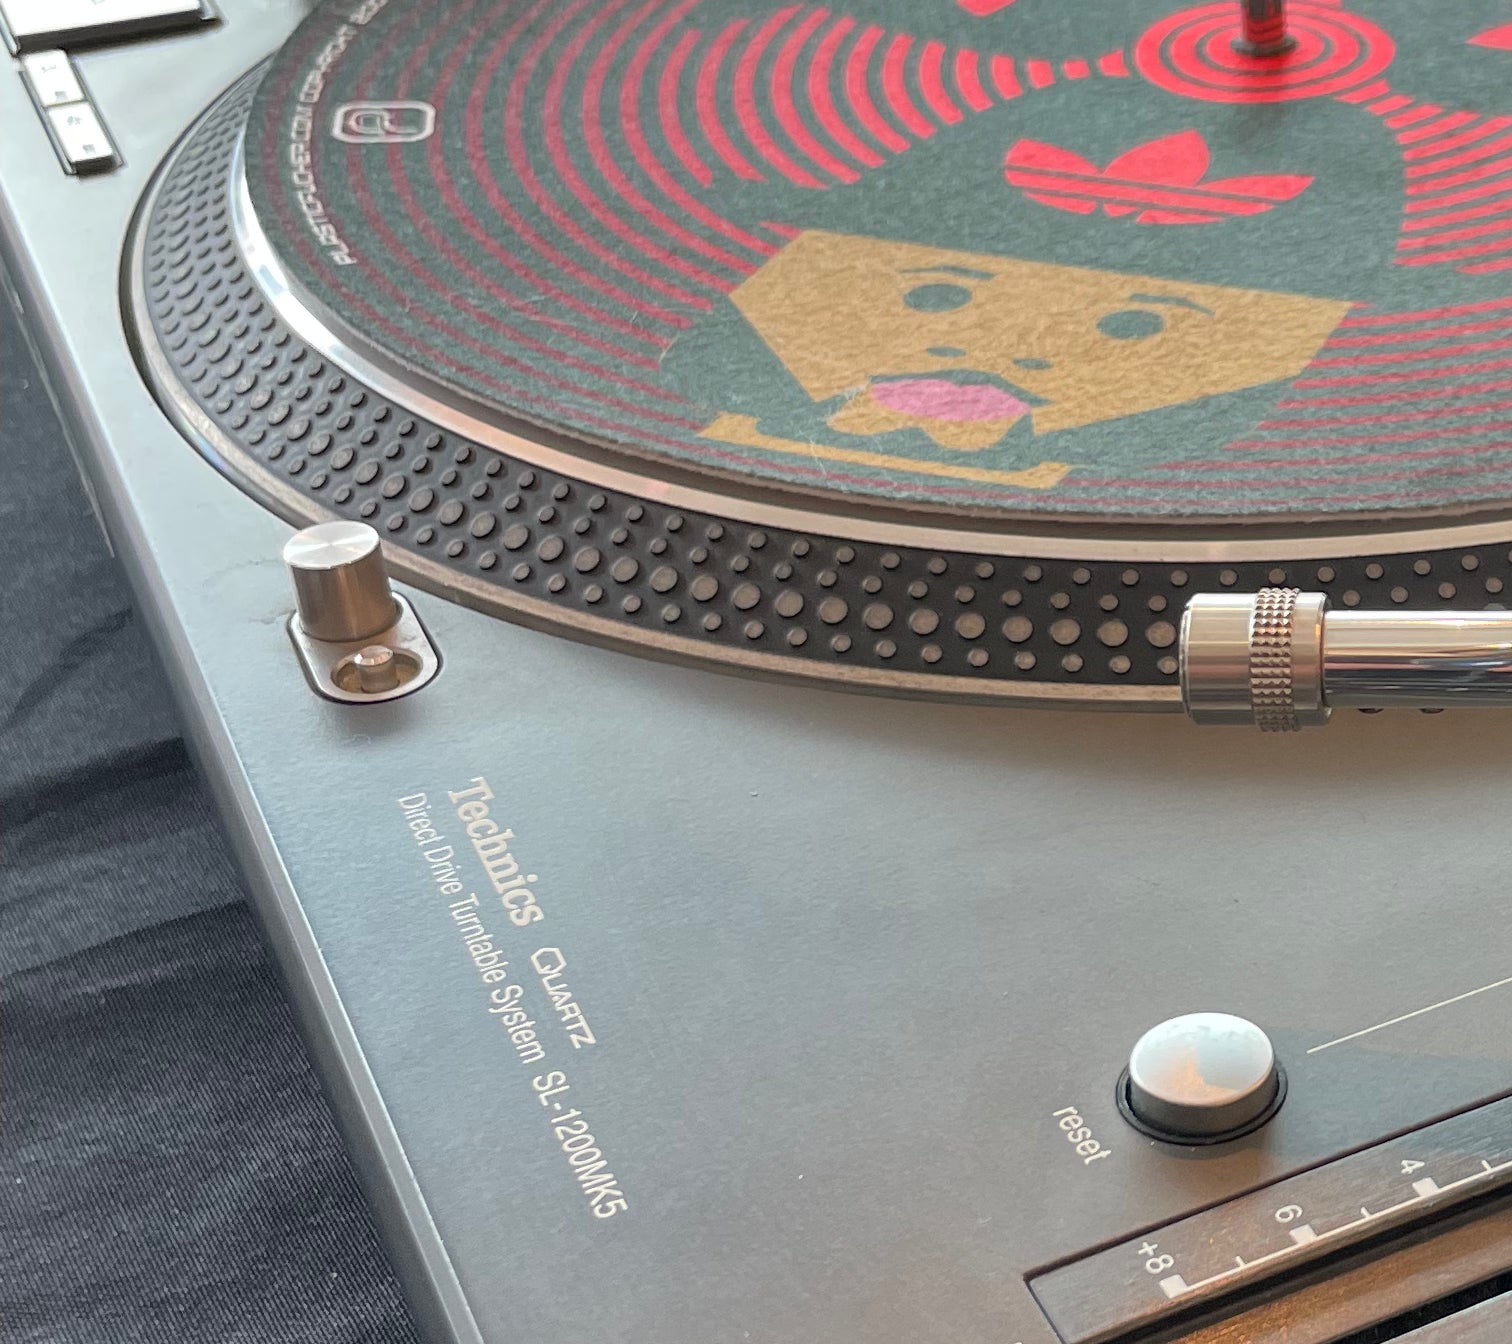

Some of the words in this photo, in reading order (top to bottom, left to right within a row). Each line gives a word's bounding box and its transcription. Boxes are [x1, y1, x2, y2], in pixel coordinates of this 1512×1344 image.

[397, 792, 441, 847] Direct
[424, 845, 463, 896] Drive
[449, 893, 506, 984] Turntable
[488, 984, 546, 1066] System
[533, 1070, 629, 1220] SL-1200MK5
[449, 776, 544, 927] Technics
[530, 946, 597, 1049] QUARTZ
[1052, 1105, 1112, 1166] reset
[1137, 1239, 1174, 1275] +8
[1274, 1204, 1303, 1223] 6
[1399, 1159, 1425, 1174] 4
